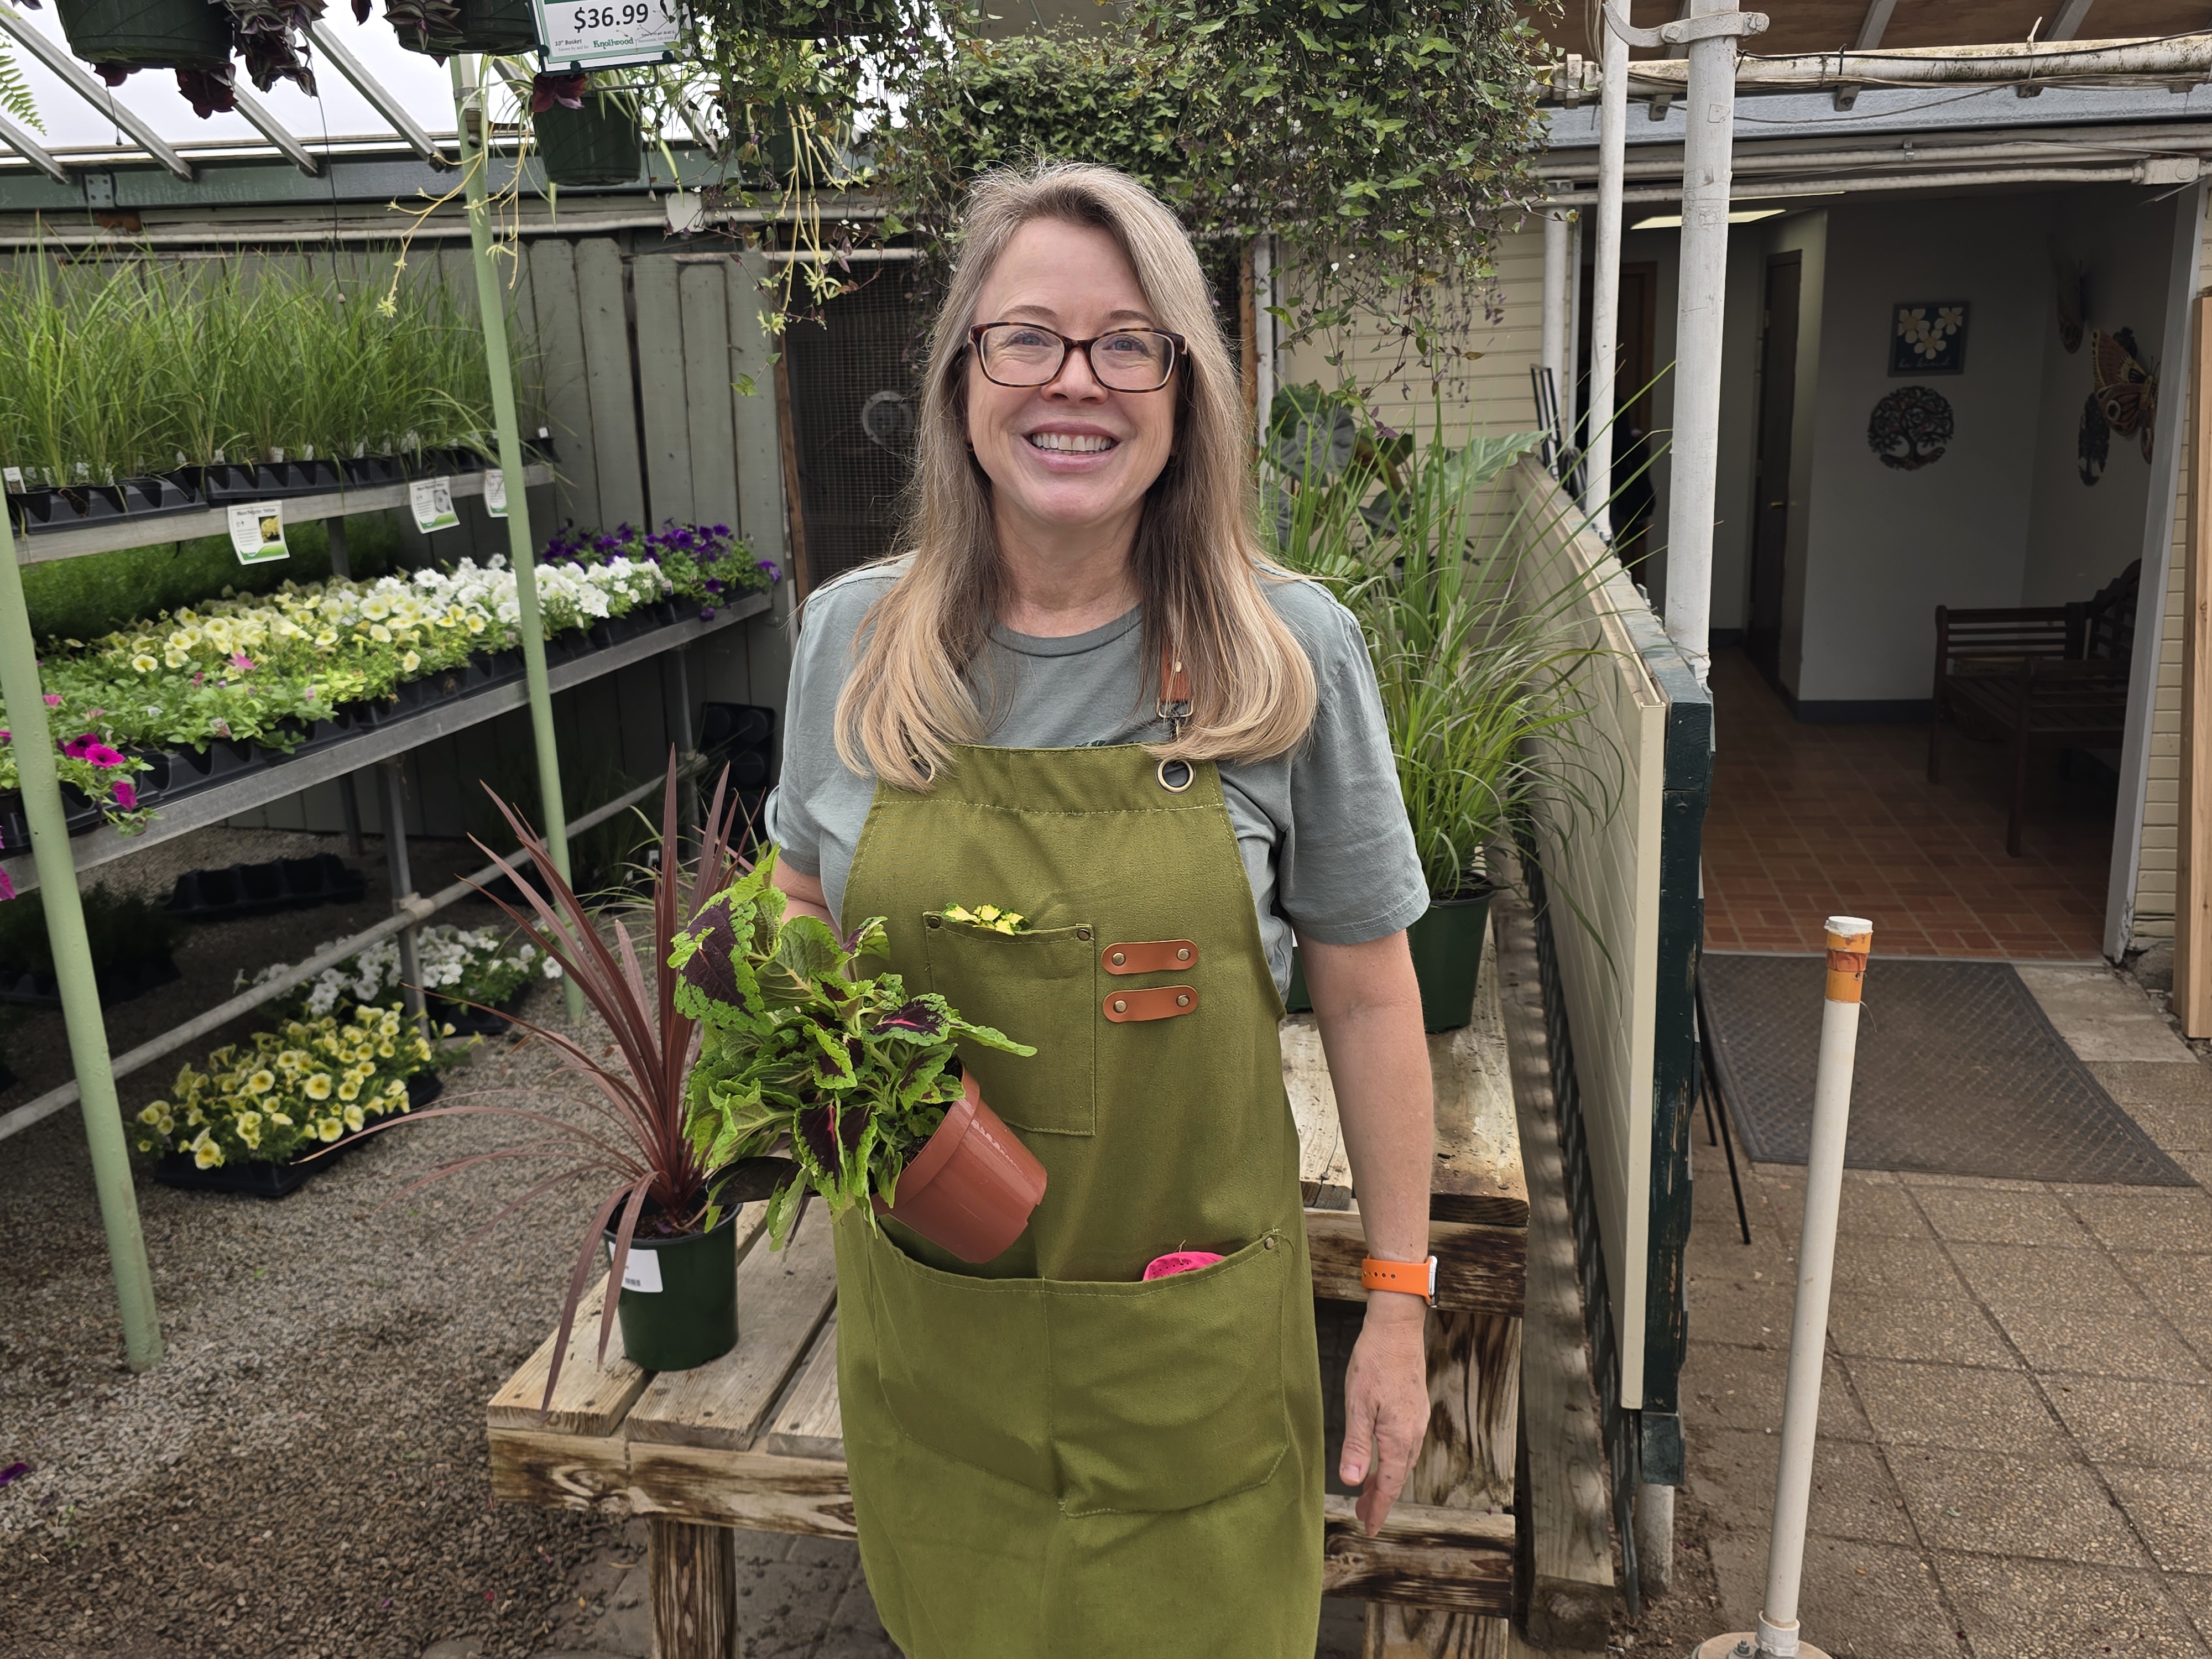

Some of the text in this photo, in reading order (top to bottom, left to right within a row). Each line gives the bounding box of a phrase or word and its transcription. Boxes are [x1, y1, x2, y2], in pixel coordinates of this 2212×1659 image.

[574, 3, 649, 33] $36.99
[593, 37, 634, 50] Knollwood
[1917, 355, 1950, 368] kind
